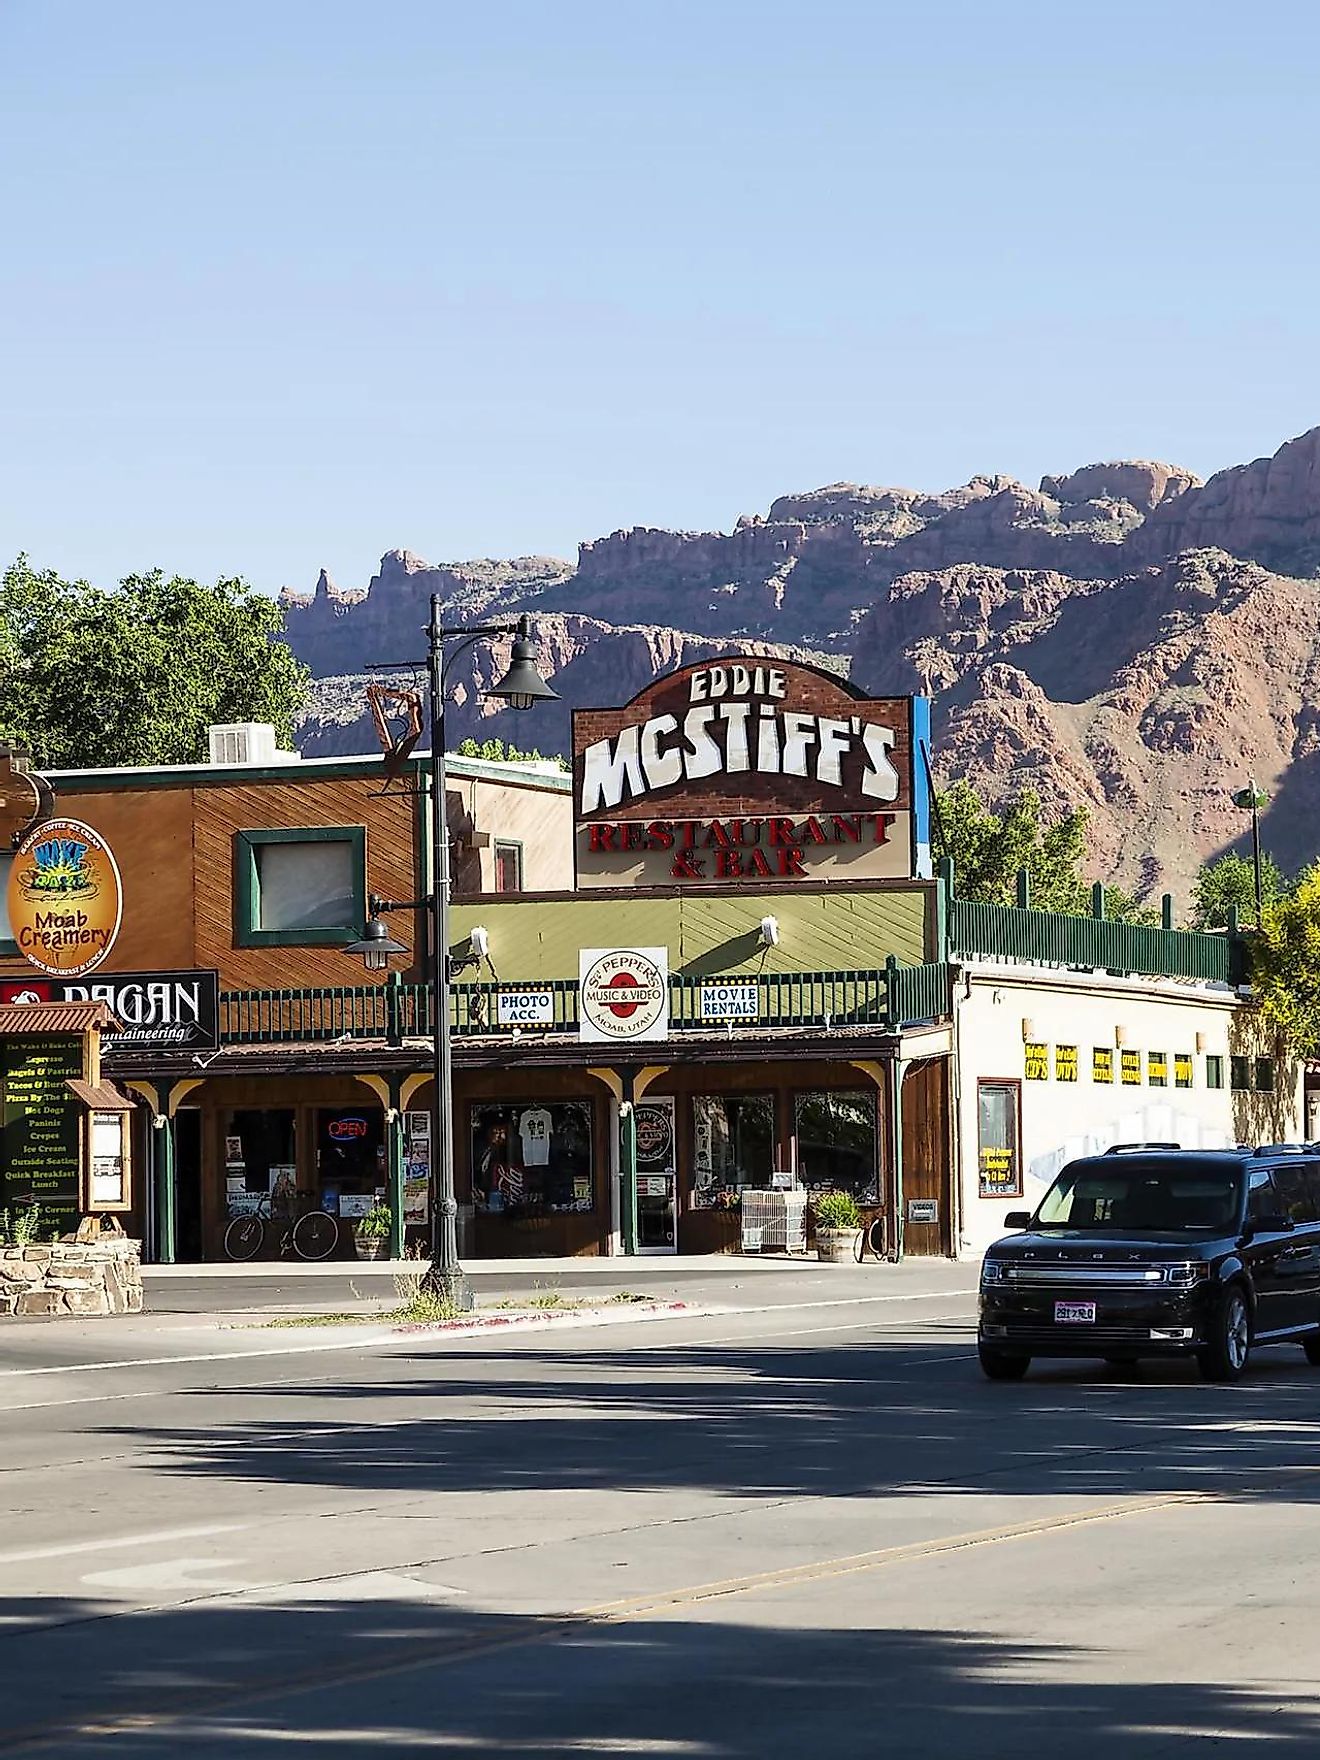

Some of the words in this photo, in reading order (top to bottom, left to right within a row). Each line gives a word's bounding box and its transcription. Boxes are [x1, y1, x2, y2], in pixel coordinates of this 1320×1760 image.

[689, 664, 786, 703] EDDIE
[43, 822, 67, 833] COFFEE
[80, 828, 102, 850] CREAM
[588, 814, 896, 853] RESTAURANT
[33, 839, 89, 869] WAKE
[670, 849, 705, 879] &
[713, 847, 810, 878] BAR
[34, 909, 88, 929] Moab
[19, 926, 111, 948] Creamery
[26, 952, 46, 971] QUICK
[45, 964, 80, 976] BREAKFAST
[86, 948, 105, 969] LUNCH
[586, 989, 620, 1001] MUSIC
[620, 990, 628, 1001] &
[630, 989, 661, 1000] VIDEO
[703, 988, 756, 1001] MOVIE
[501, 995, 550, 1008] PHOTO
[703, 1001, 756, 1015] RENTALS
[509, 1010, 540, 1020] ACC.
[627, 1011, 653, 1032] UTAH
[37, 1068, 46, 1076] &
[47, 1067, 81, 1076] Pastries
[8, 1082, 33, 1090] Tacos
[34, 1081, 43, 1089] &
[6, 1094, 29, 1102] Pizza
[30, 1094, 43, 1102] By
[43, 1093, 61, 1101] The
[25, 1107, 41, 1115] Hot
[43, 1106, 65, 1115] Dogs
[29, 1119, 61, 1127] Paninis
[329, 1121, 368, 1136] OPEN
[30, 1132, 60, 1140] Crepes
[23, 1145, 36, 1153] Ice
[38, 1145, 67, 1153] Cream
[46, 1157, 78, 1166] Seating
[5, 1171, 31, 1180] Quick
[33, 1170, 76, 1179] Breakfast
